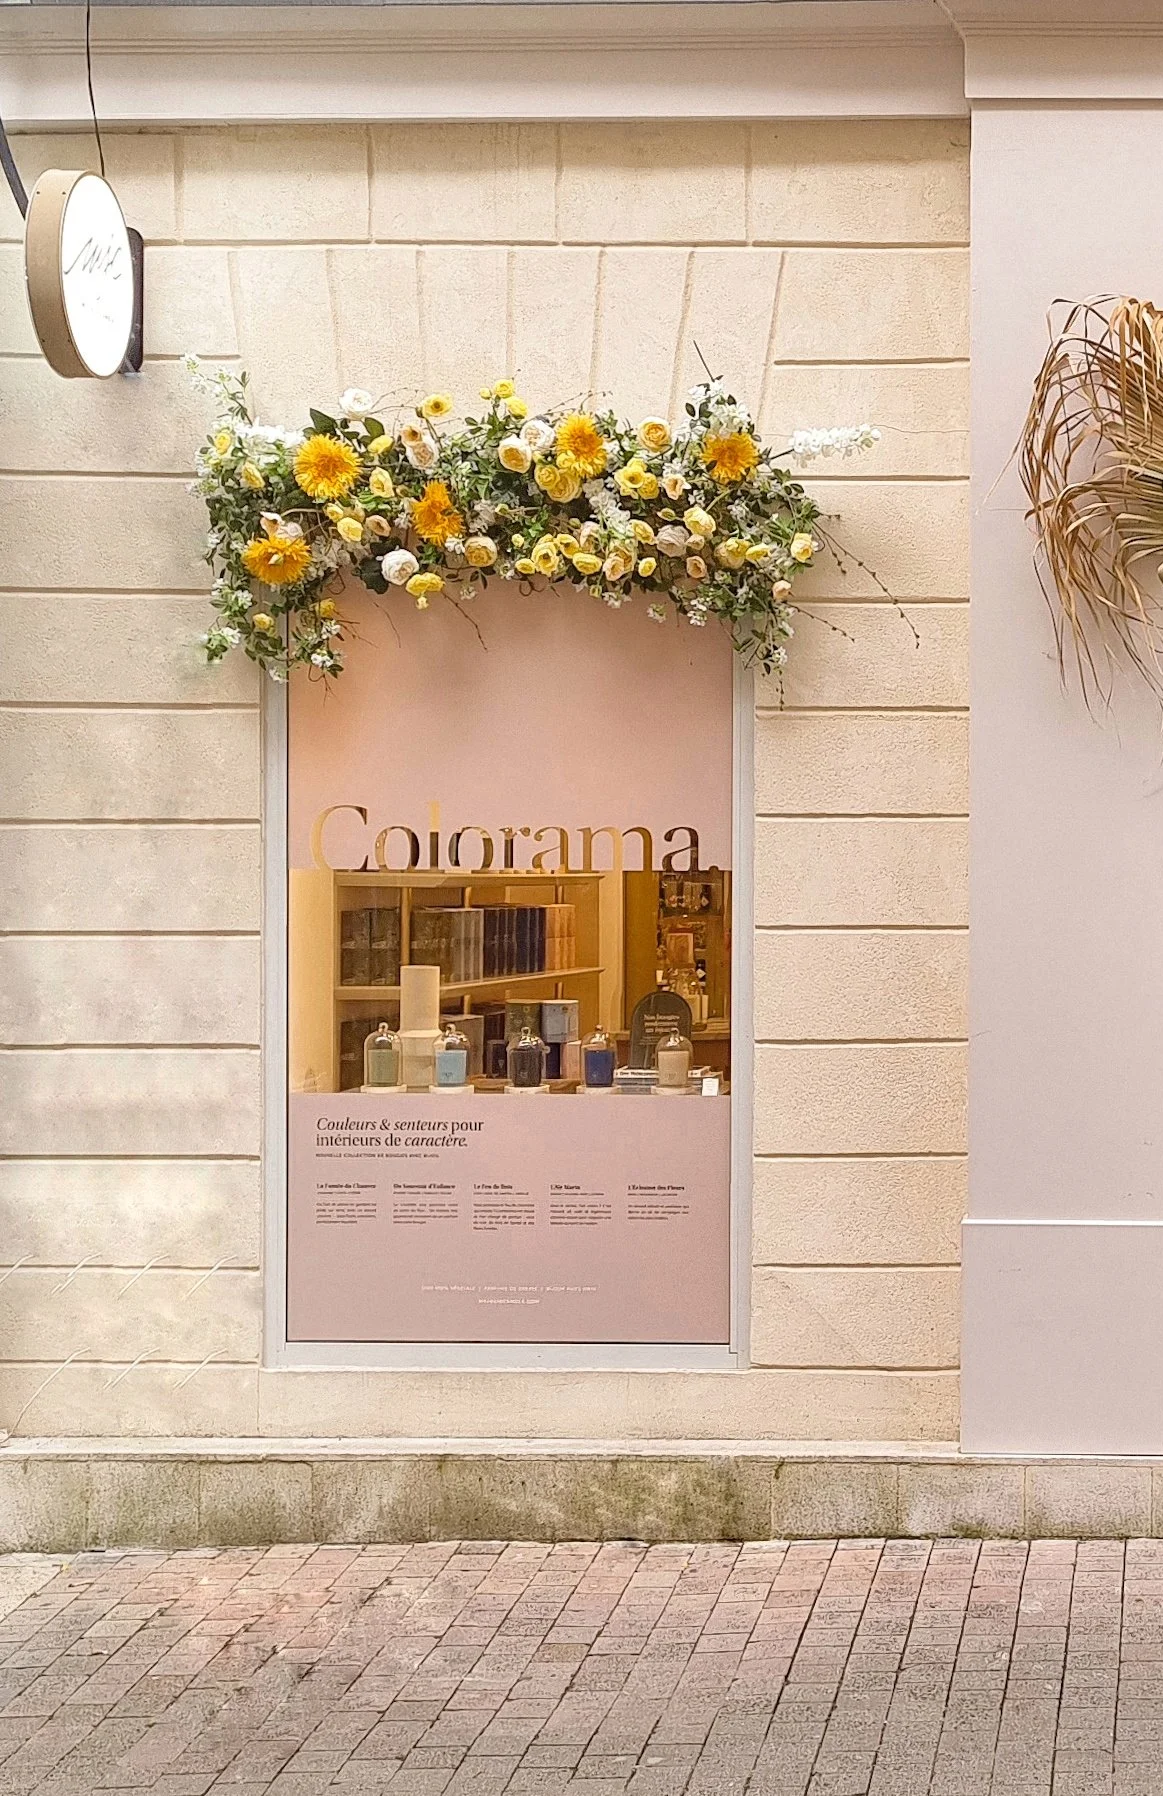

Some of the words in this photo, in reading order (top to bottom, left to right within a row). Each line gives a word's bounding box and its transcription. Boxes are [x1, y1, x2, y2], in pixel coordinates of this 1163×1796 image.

[316, 1117, 377, 1131] Couleurs
[379, 1118, 391, 1131] &
[393, 1119, 449, 1131] senteurs
[451, 1121, 485, 1134] pour
[316, 1133, 382, 1147] intérieurs
[384, 1133, 401, 1147] de
[404, 1134, 469, 1147] caractère.
